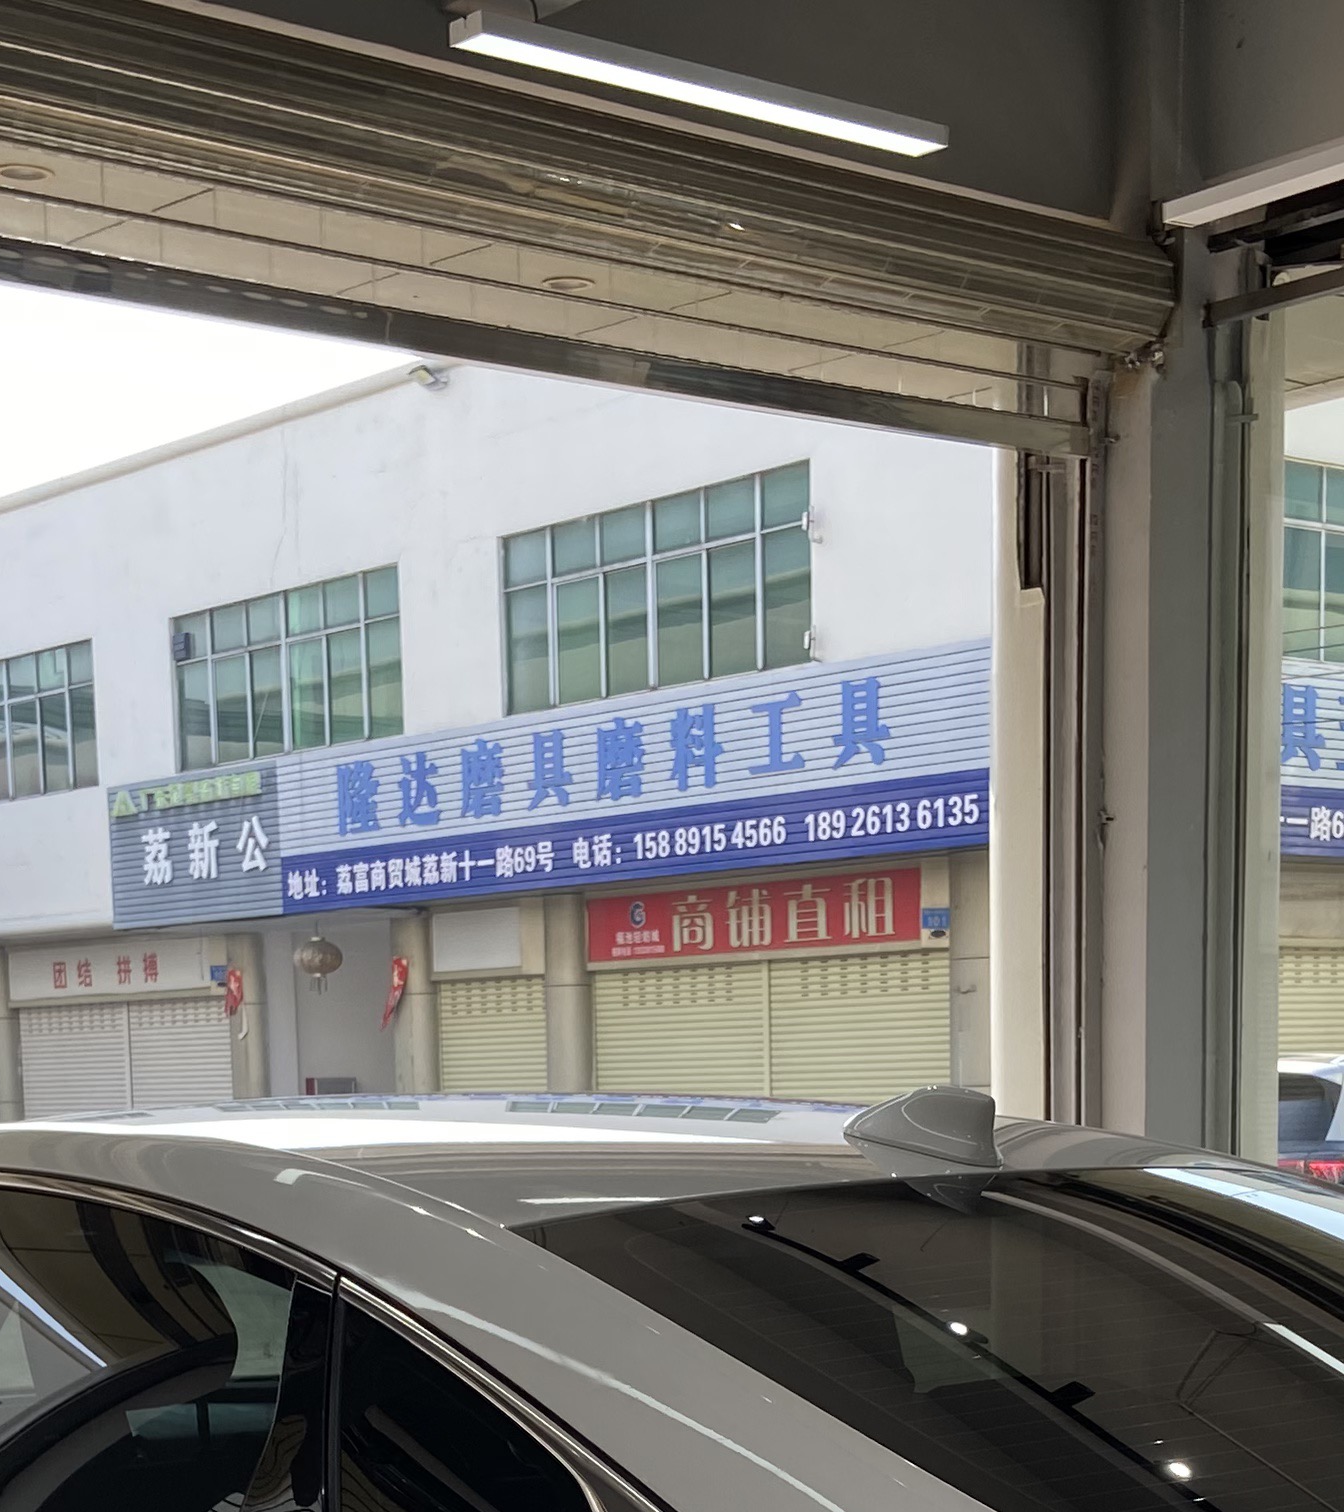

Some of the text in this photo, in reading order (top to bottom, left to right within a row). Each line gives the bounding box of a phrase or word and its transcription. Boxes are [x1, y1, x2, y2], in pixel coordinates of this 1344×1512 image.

[336, 676, 891, 837] 隆达磨具磨料工具
[141, 815, 270, 886] 荔新公
[336, 841, 555, 895] 荔富商贸城荔新十一路69号
[670, 877, 896, 952] 商铺直租
[53, 952, 159, 989] 团结 拼搏
